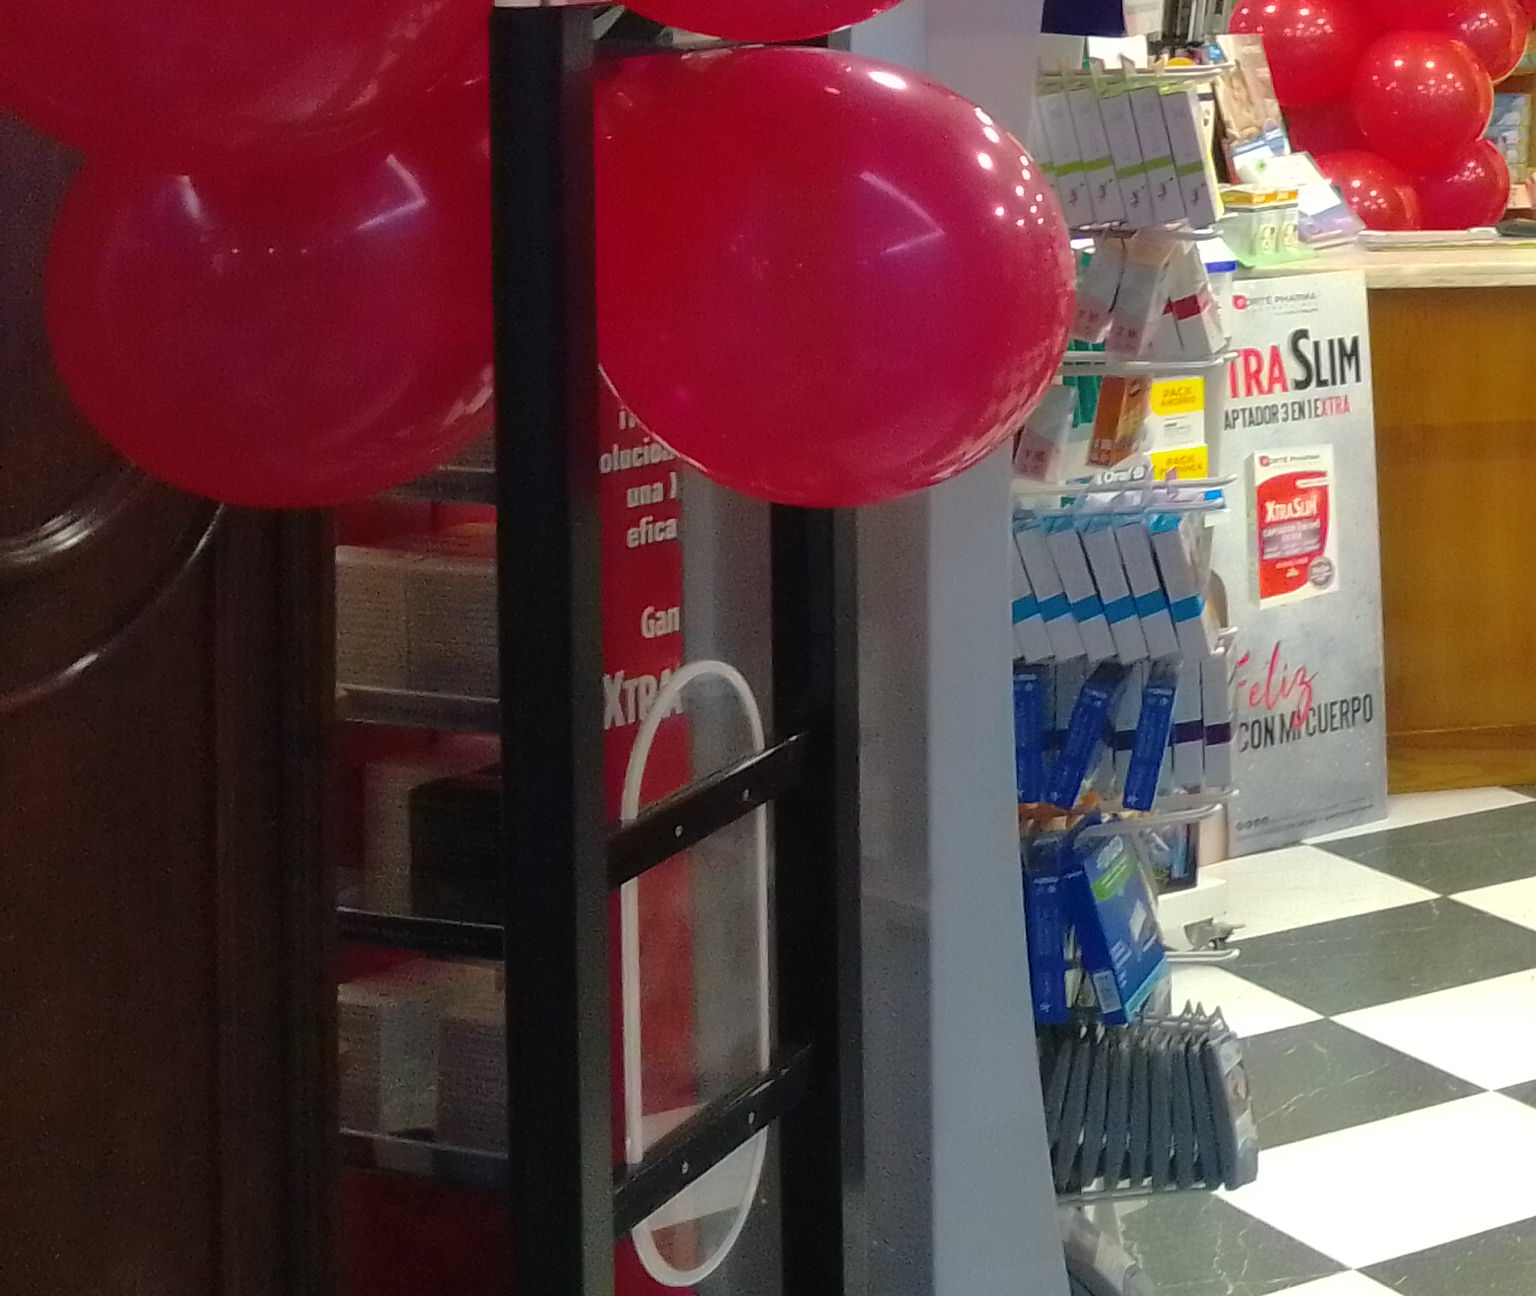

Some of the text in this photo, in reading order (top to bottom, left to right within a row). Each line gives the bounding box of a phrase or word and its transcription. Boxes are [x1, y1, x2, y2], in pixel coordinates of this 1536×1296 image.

[1224, 404, 1279, 431] APTADOR
[626, 515, 678, 549] efica
[1305, 693, 1374, 738] CUERPO
